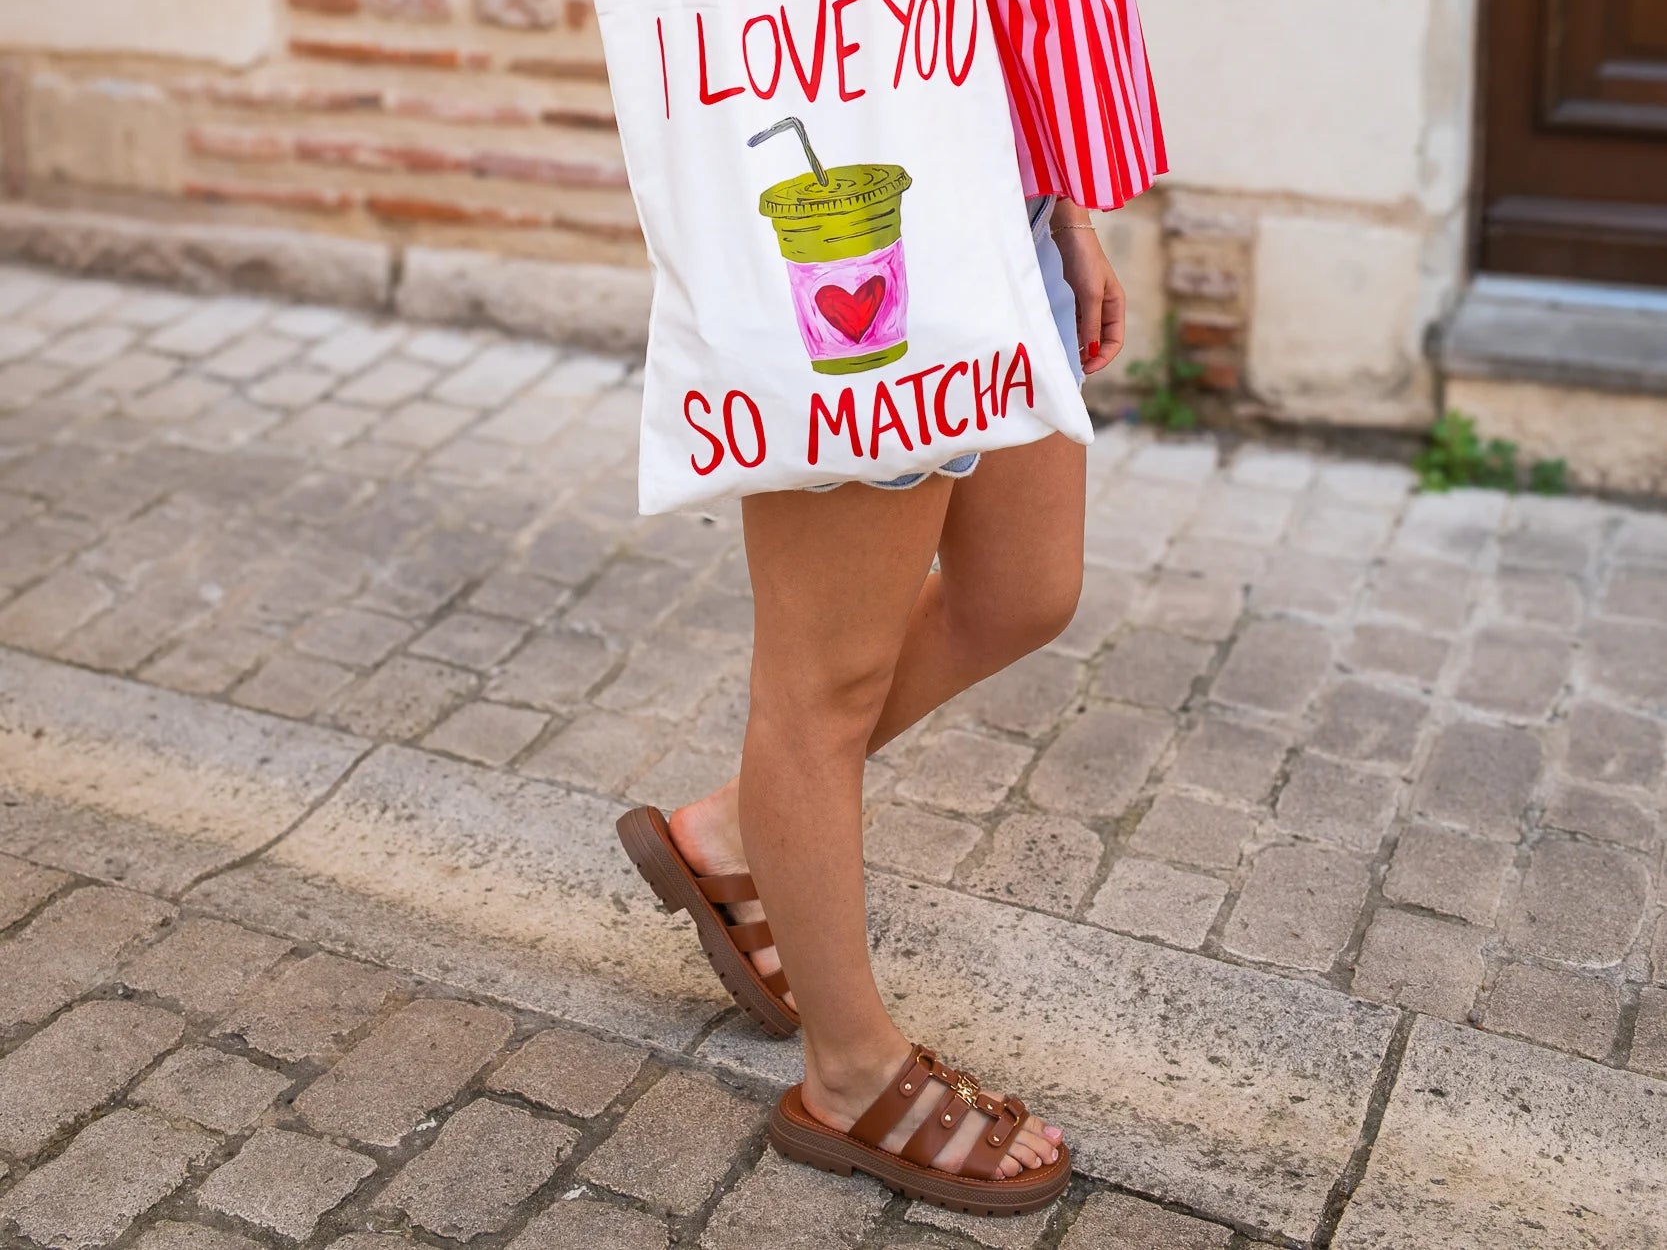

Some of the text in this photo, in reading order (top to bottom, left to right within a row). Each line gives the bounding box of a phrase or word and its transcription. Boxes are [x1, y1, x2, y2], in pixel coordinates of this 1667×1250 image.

[656, 16, 670, 120] I
[683, 342, 1035, 477] SO MATCHA
